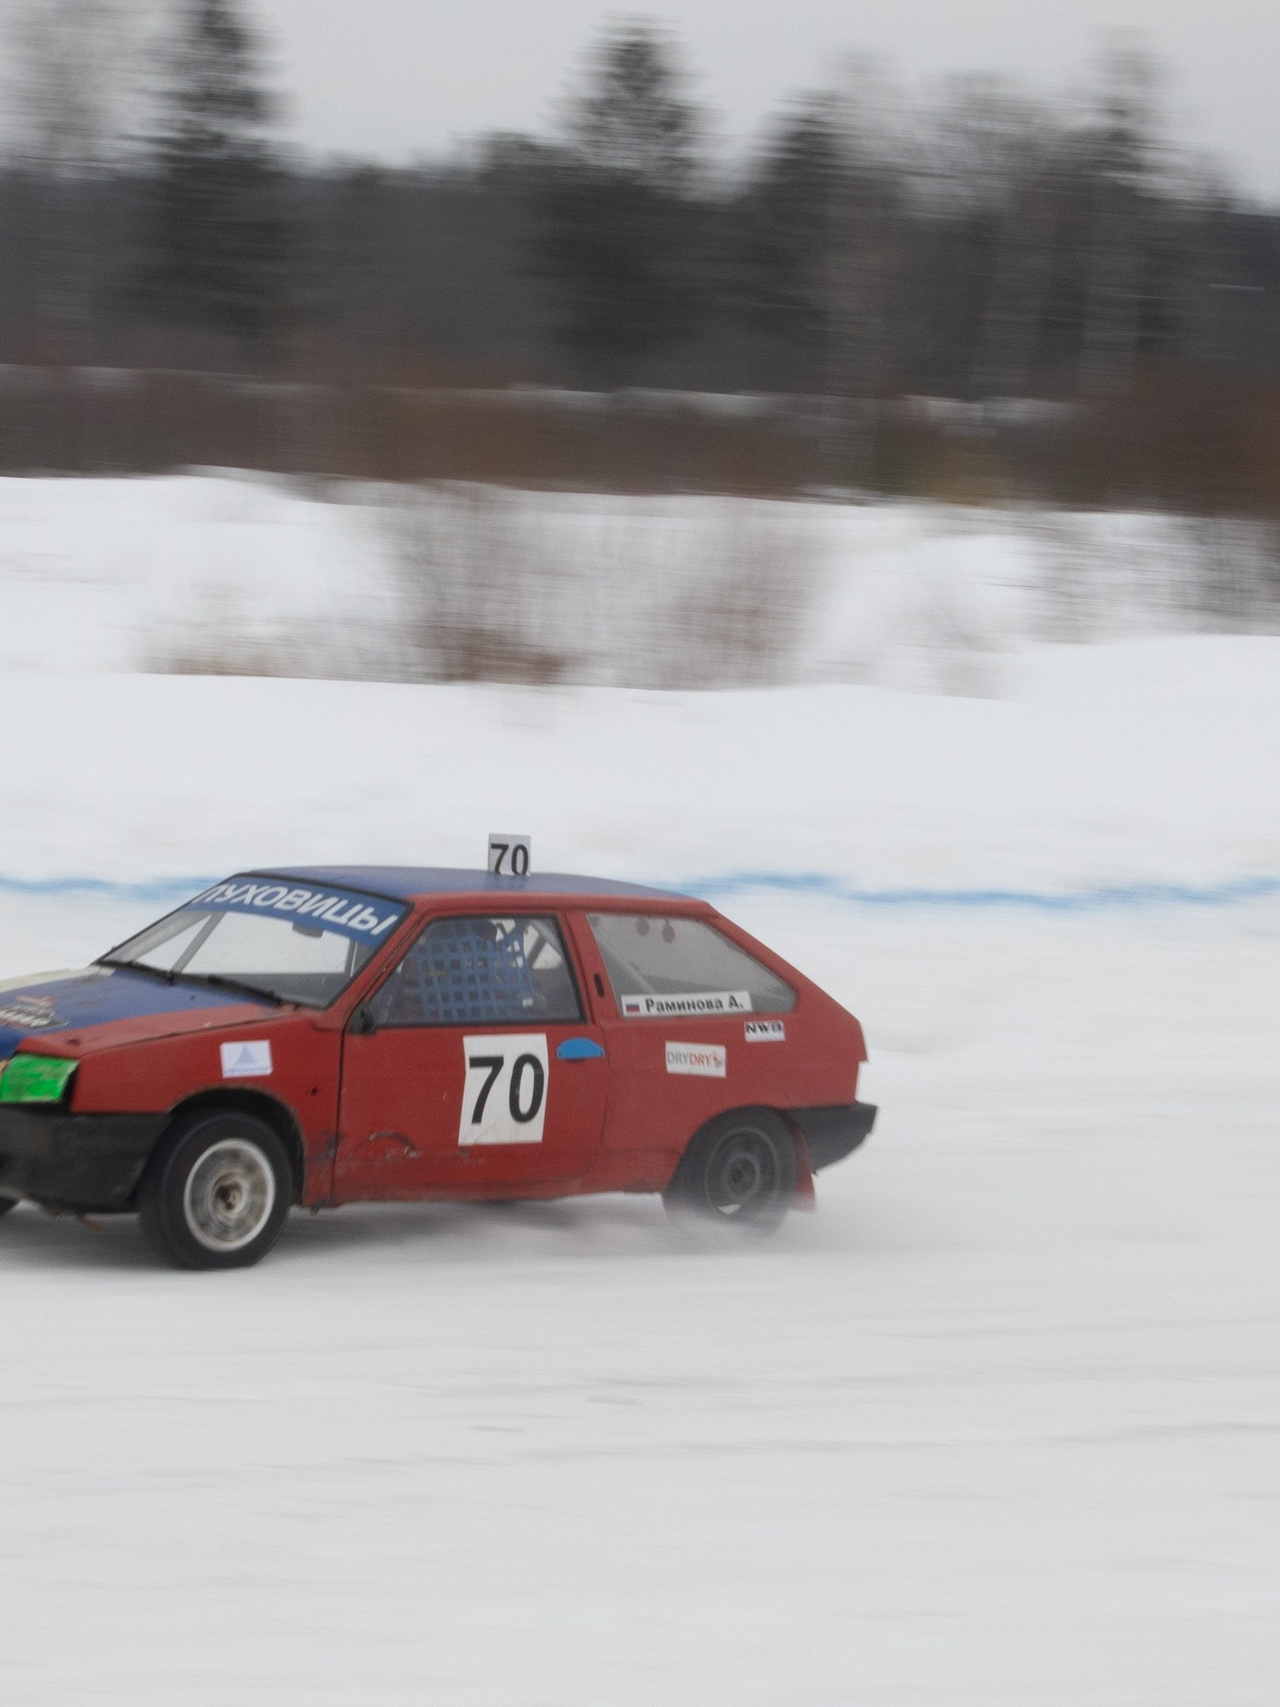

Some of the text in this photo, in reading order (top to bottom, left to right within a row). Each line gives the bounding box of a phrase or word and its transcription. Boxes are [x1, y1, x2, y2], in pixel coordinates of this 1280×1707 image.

[490, 842, 529, 876] 70
[191, 883, 399, 936] ЛУХОВИЦЫ
[645, 997, 724, 1013] Раминова
[469, 1053, 544, 1125] 70
